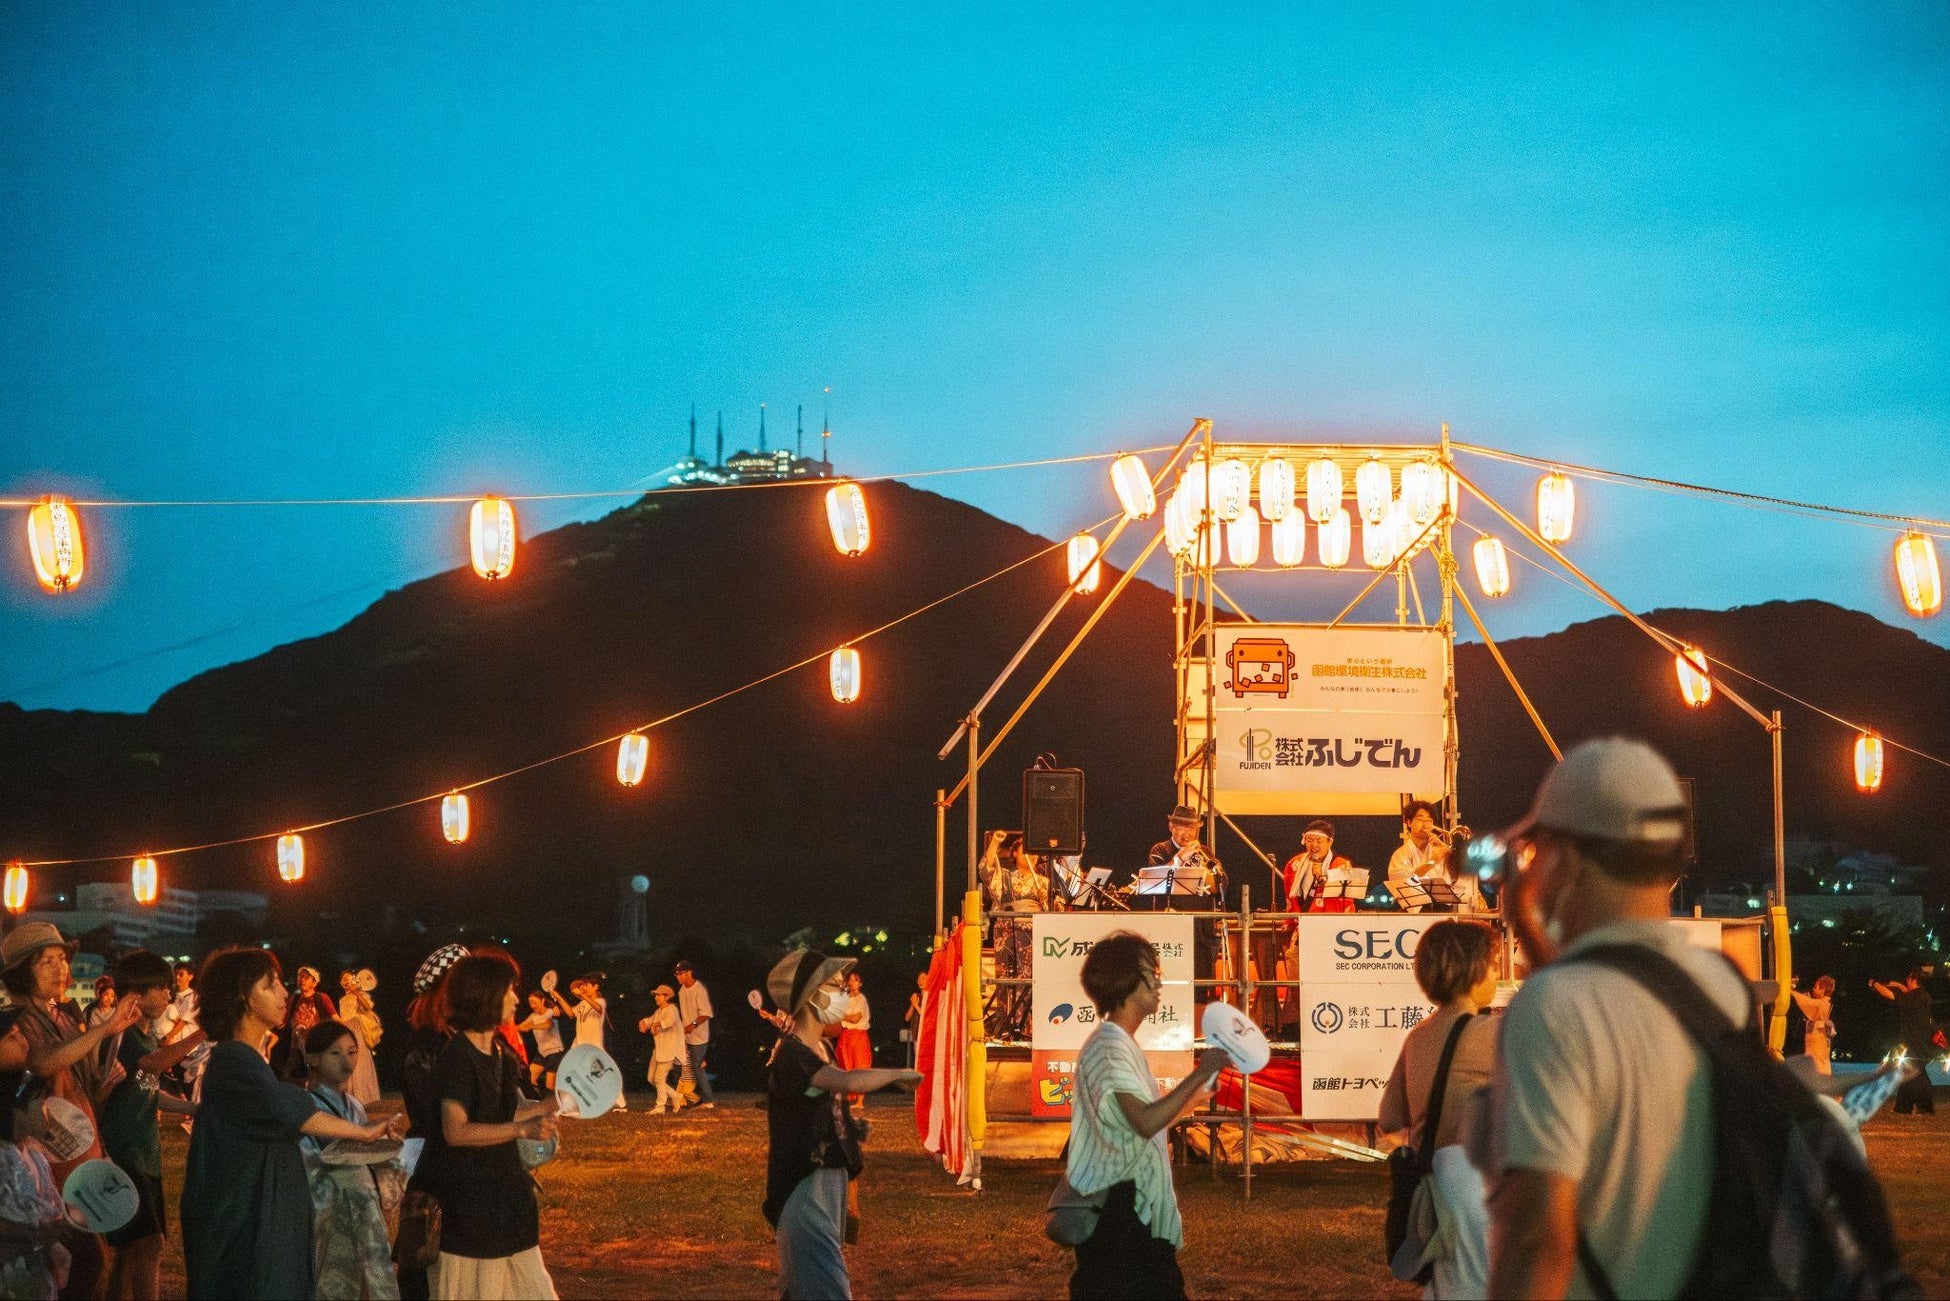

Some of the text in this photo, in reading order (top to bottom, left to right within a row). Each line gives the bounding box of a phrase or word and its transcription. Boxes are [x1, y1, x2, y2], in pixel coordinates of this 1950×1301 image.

[1311, 664, 1428, 680] 函館環境衛生株式会社
[1305, 738, 1422, 768] ふじでん
[1239, 761, 1272, 770] FUJIDEN
[1333, 928, 1420, 960] SEC
[1335, 962, 1416, 970] SEC CORPORATION LT
[1374, 1005, 1437, 1030] 工藤
